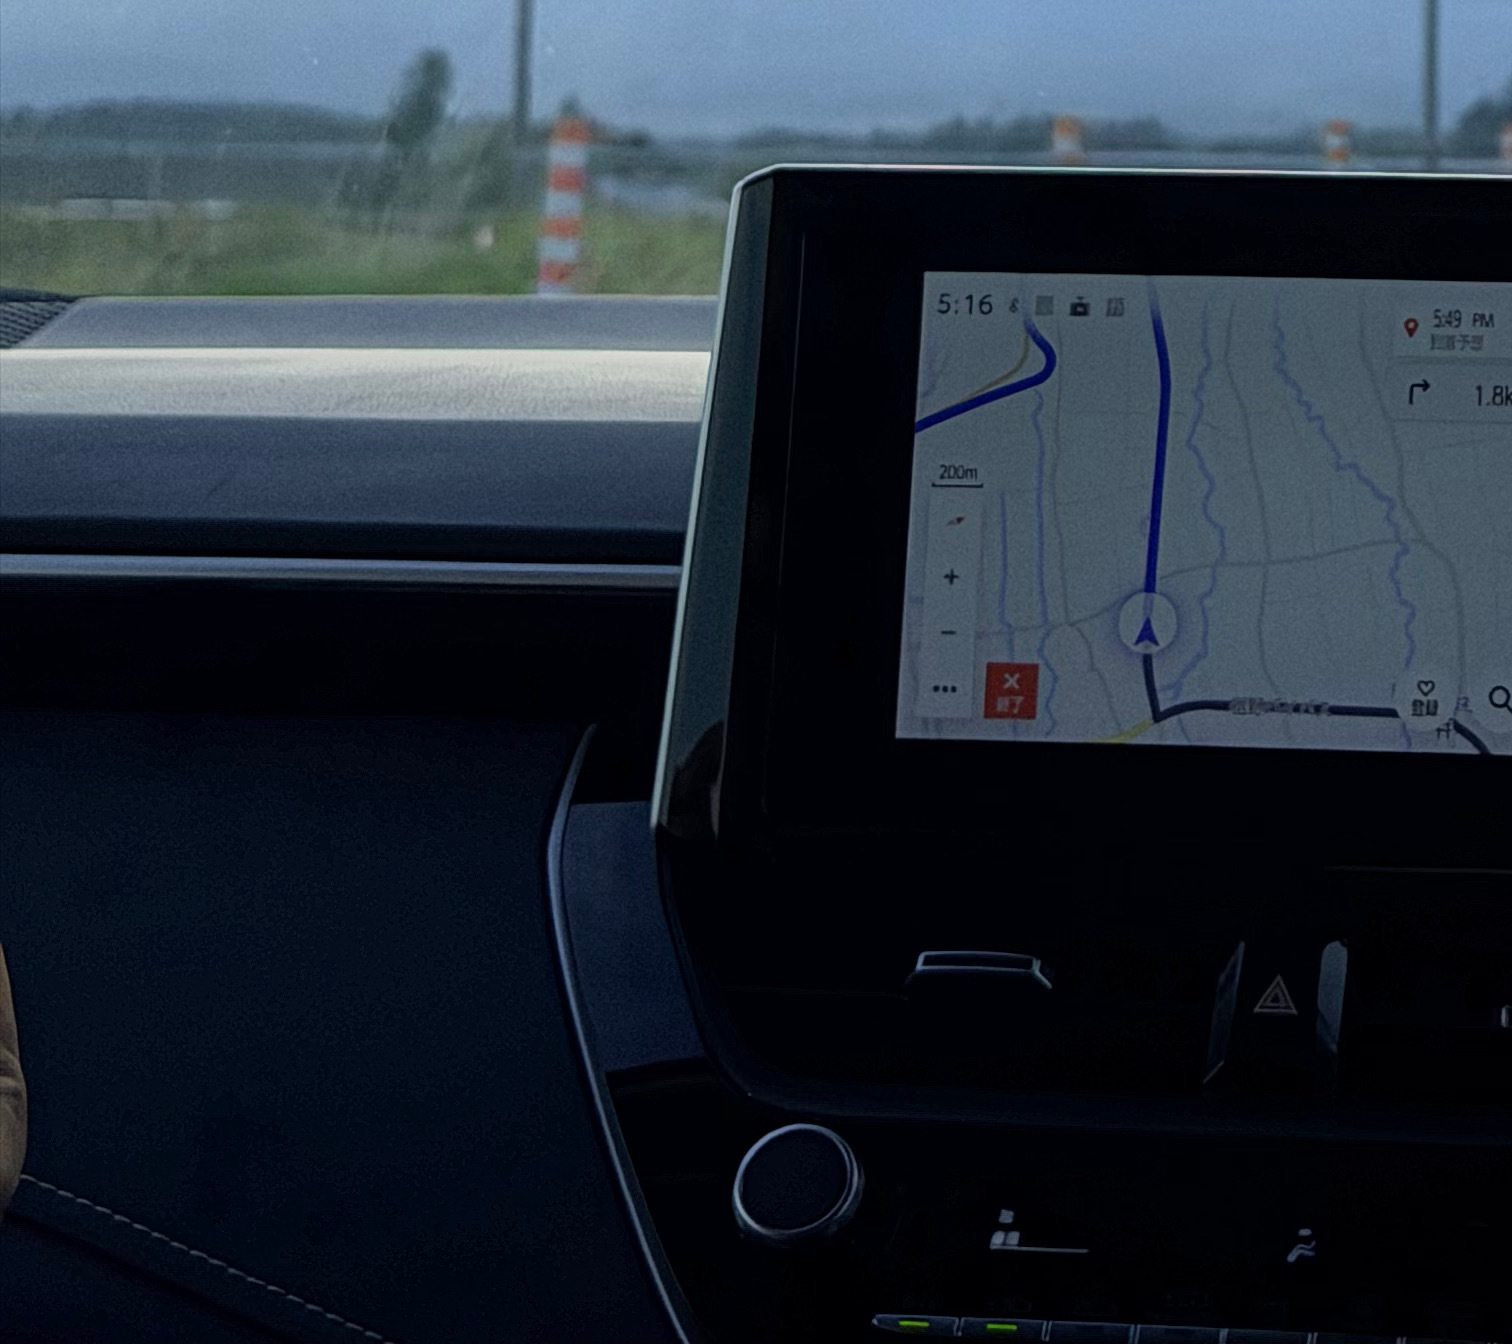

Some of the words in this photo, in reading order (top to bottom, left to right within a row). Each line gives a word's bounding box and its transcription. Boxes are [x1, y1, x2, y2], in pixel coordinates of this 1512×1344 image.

[937, 293, 993, 315] 5:16
[1433, 309, 1462, 328] 5:49
[1472, 313, 1495, 328] PM
[939, 464, 978, 481] 200m
